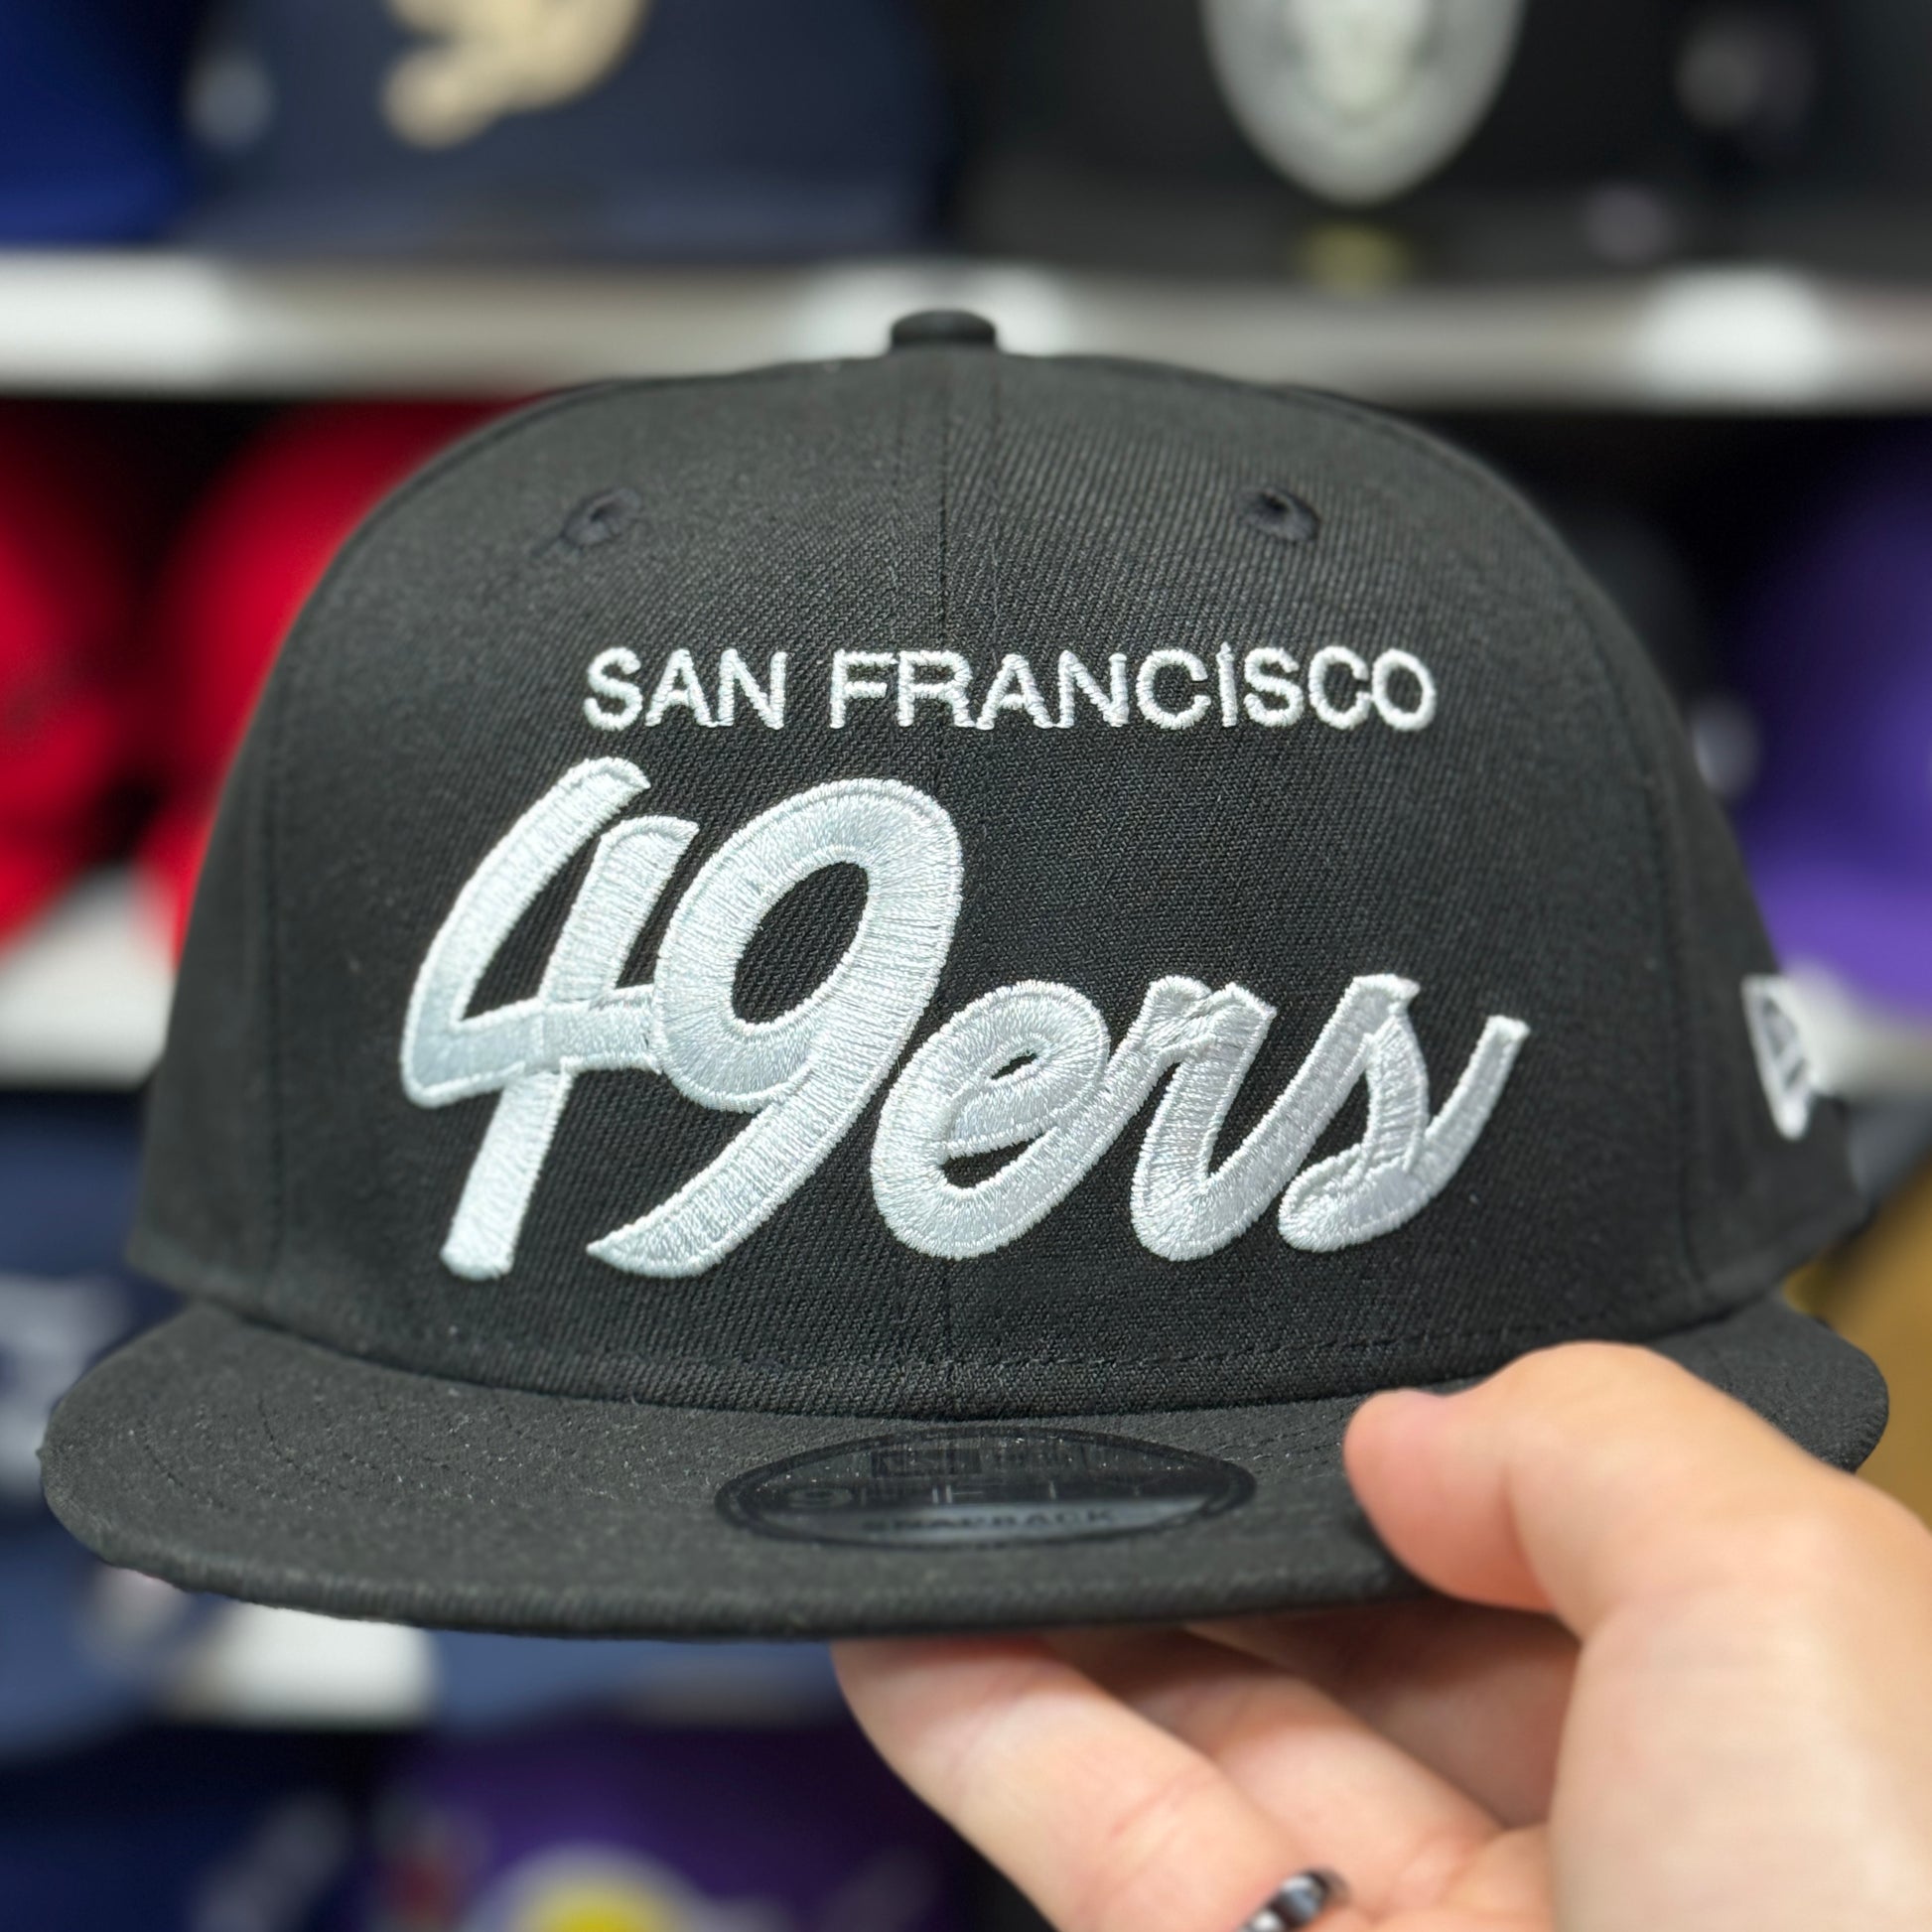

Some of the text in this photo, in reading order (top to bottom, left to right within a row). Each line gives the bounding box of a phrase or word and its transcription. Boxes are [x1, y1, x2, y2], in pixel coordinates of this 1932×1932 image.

[582, 641, 1439, 733] SAN FRANCISCO
[400, 755, 1530, 1280] 49ers
